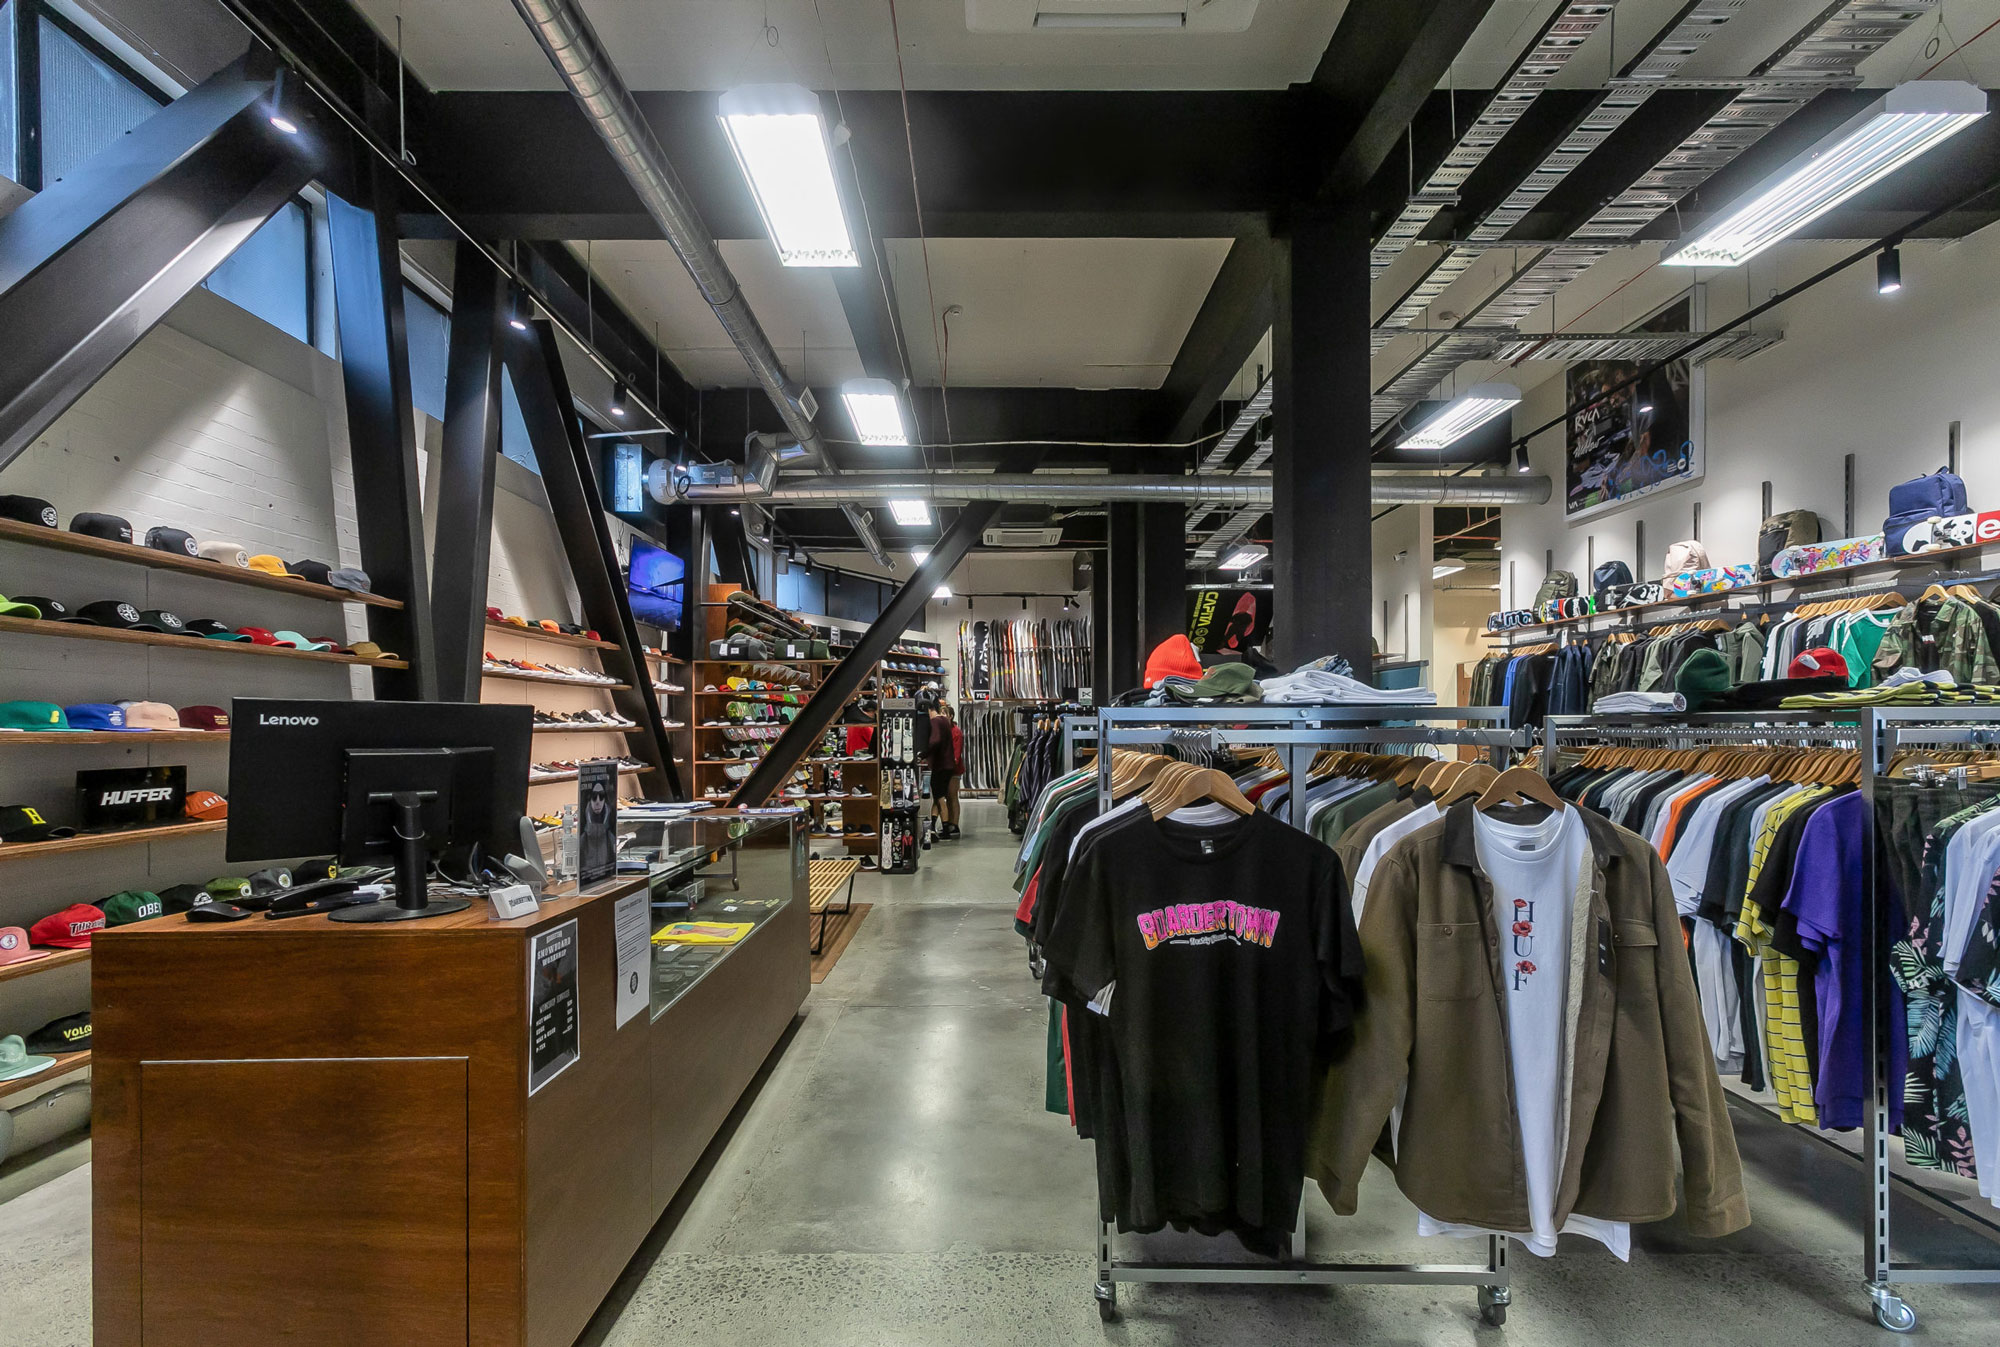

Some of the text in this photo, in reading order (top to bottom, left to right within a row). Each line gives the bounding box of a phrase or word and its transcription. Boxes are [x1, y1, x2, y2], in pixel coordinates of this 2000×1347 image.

[1574, 408, 1600, 433] RVCA
[1197, 591, 1219, 627] CAPITA
[259, 713, 320, 726] Lenovo
[100, 787, 173, 806] HUFFER
[21, 807, 47, 825] H
[1136, 899, 1281, 951] BOARDERTOWN
[537, 936, 571, 960] SNOWBOARD
[1512, 899, 1535, 991] HUF
